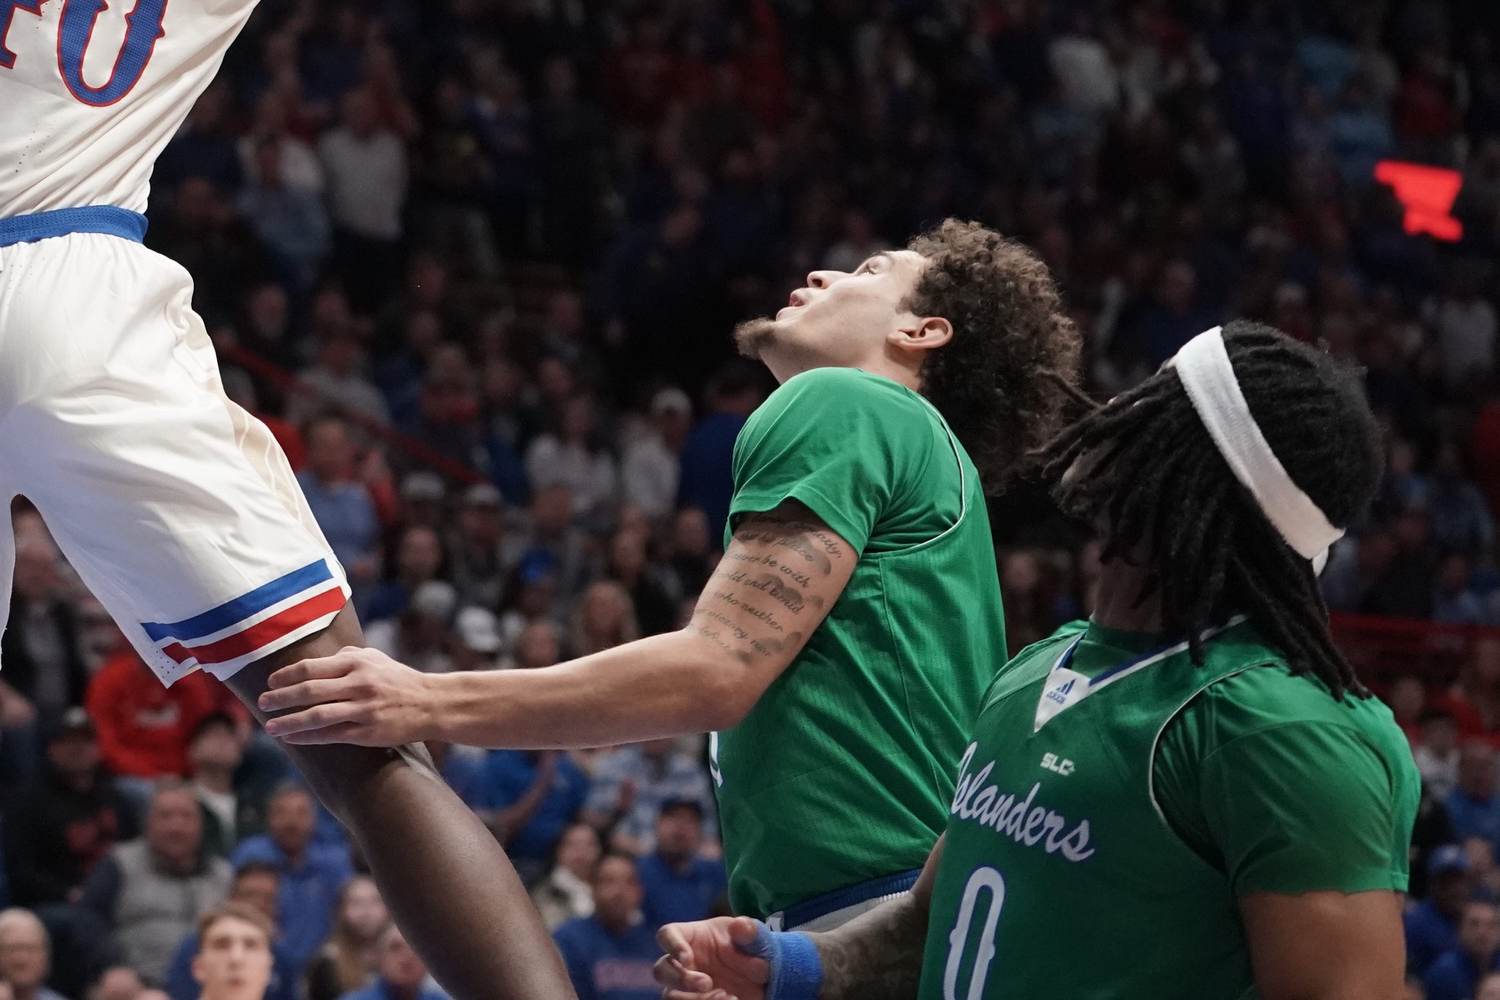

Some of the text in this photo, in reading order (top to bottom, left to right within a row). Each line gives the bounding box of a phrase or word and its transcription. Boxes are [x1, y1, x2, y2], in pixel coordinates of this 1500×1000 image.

[762, 554, 777, 567] be
[780, 565, 811, 588] with
[713, 590, 783, 633] who neither
[744, 578, 770, 592] and
[769, 586, 805, 615] timid
[942, 862, 1008, 1000] 0
